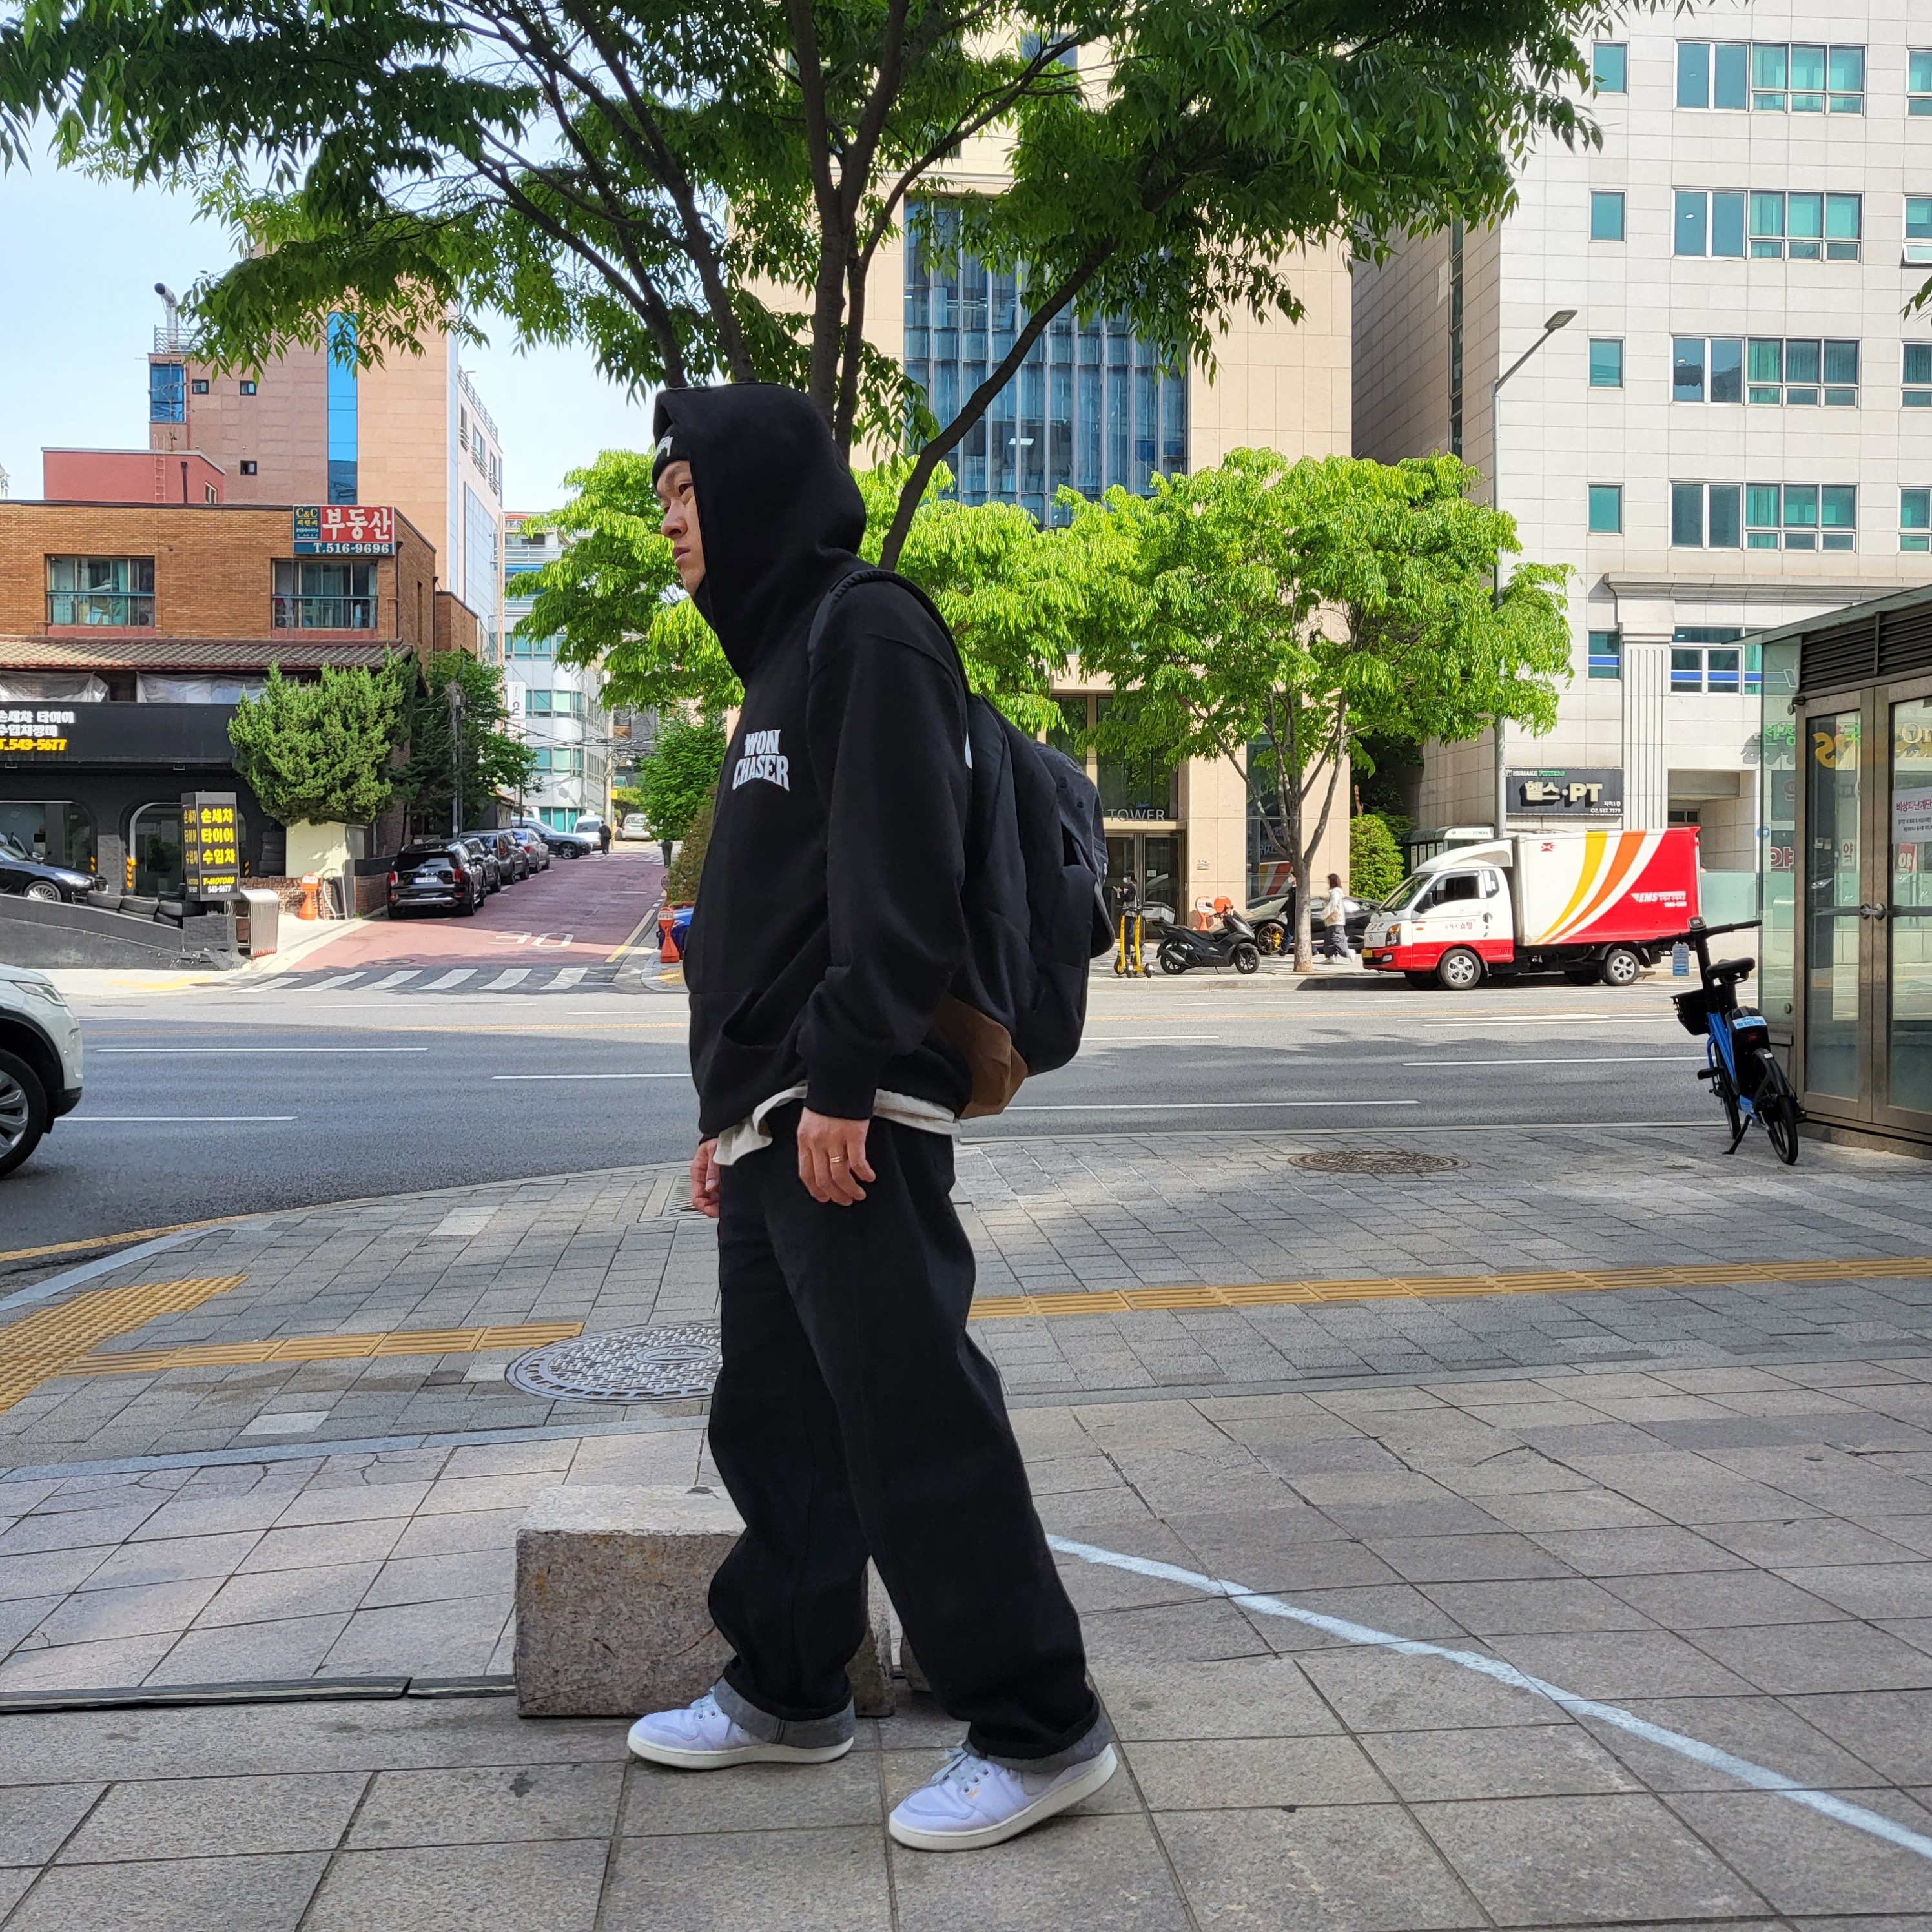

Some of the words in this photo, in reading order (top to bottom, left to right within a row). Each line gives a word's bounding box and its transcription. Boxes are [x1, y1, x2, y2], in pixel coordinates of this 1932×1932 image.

[296, 508, 318, 518] C&C
[322, 508, 391, 540] 부동산
[313, 542, 389, 554] T.516-9696
[37, 711, 75, 724] 타이어
[732, 755, 790, 792] CHASER
[200, 808, 233, 823] 손세차
[1107, 809, 1165, 822] TOWER
[201, 827, 234, 843] 타이어
[203, 848, 235, 865] 수입차
[203, 876, 235, 885] T-MOTORS
[207, 885, 231, 894] 543-5677
[1639, 892, 1658, 903] EMS
[488, 931, 575, 948] 30
